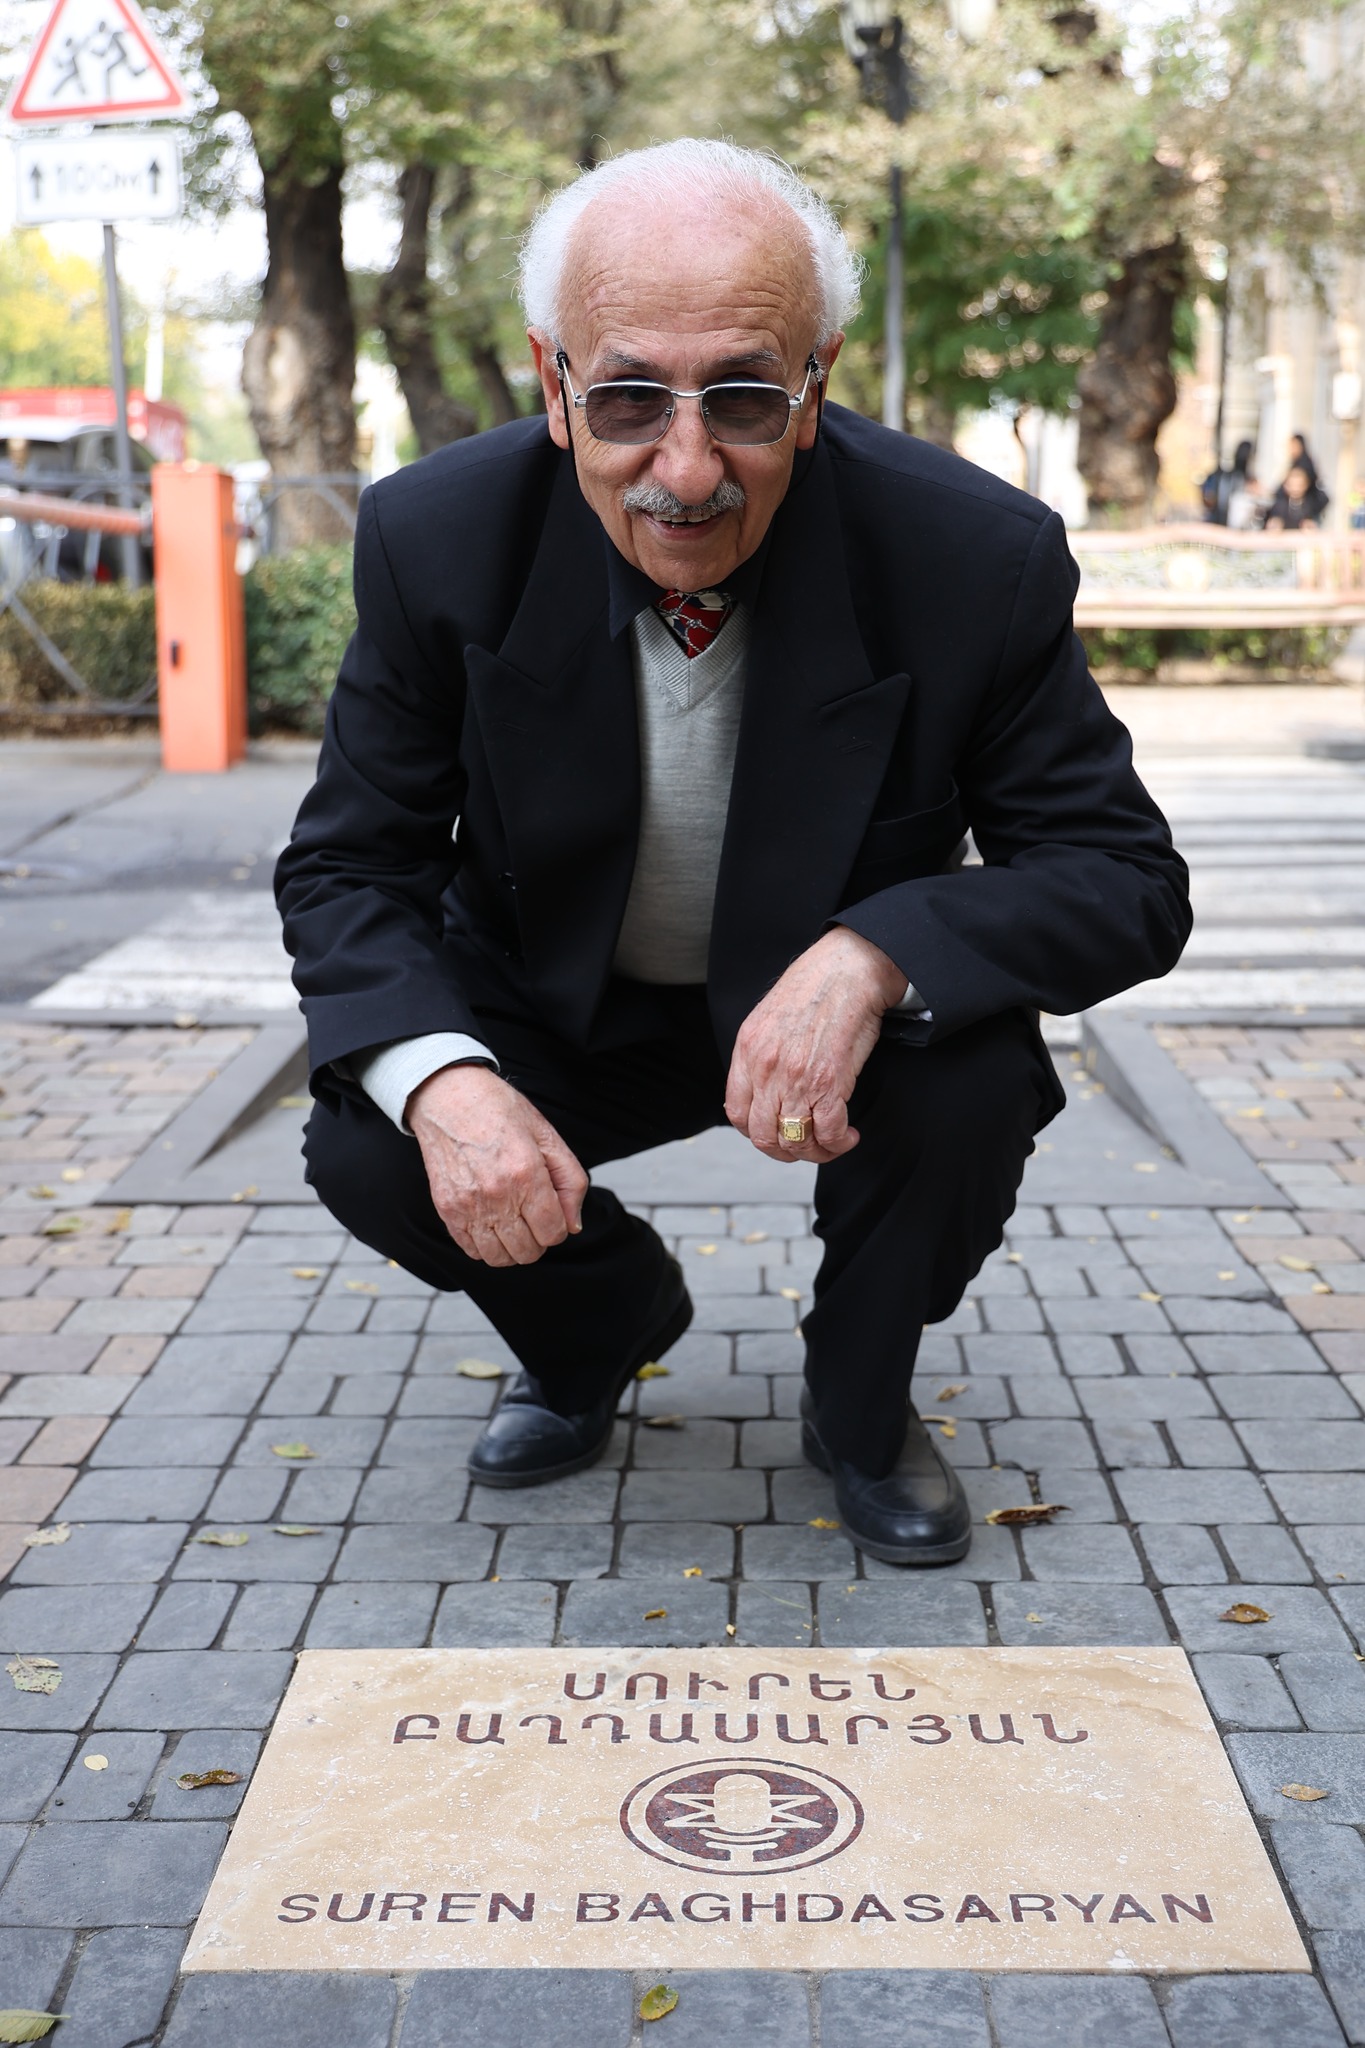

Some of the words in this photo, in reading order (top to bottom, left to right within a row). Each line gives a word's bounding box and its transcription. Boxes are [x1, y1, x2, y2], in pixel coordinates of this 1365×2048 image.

[563, 1671, 916, 1702] ՍՈՒՐԵՆ
[392, 1712, 1090, 1746] ԲԱՂԴԱՍԱՐՅԱՆ
[277, 1892, 536, 1924] SUREN
[575, 1892, 1215, 1924] BAGHDASARYAN
